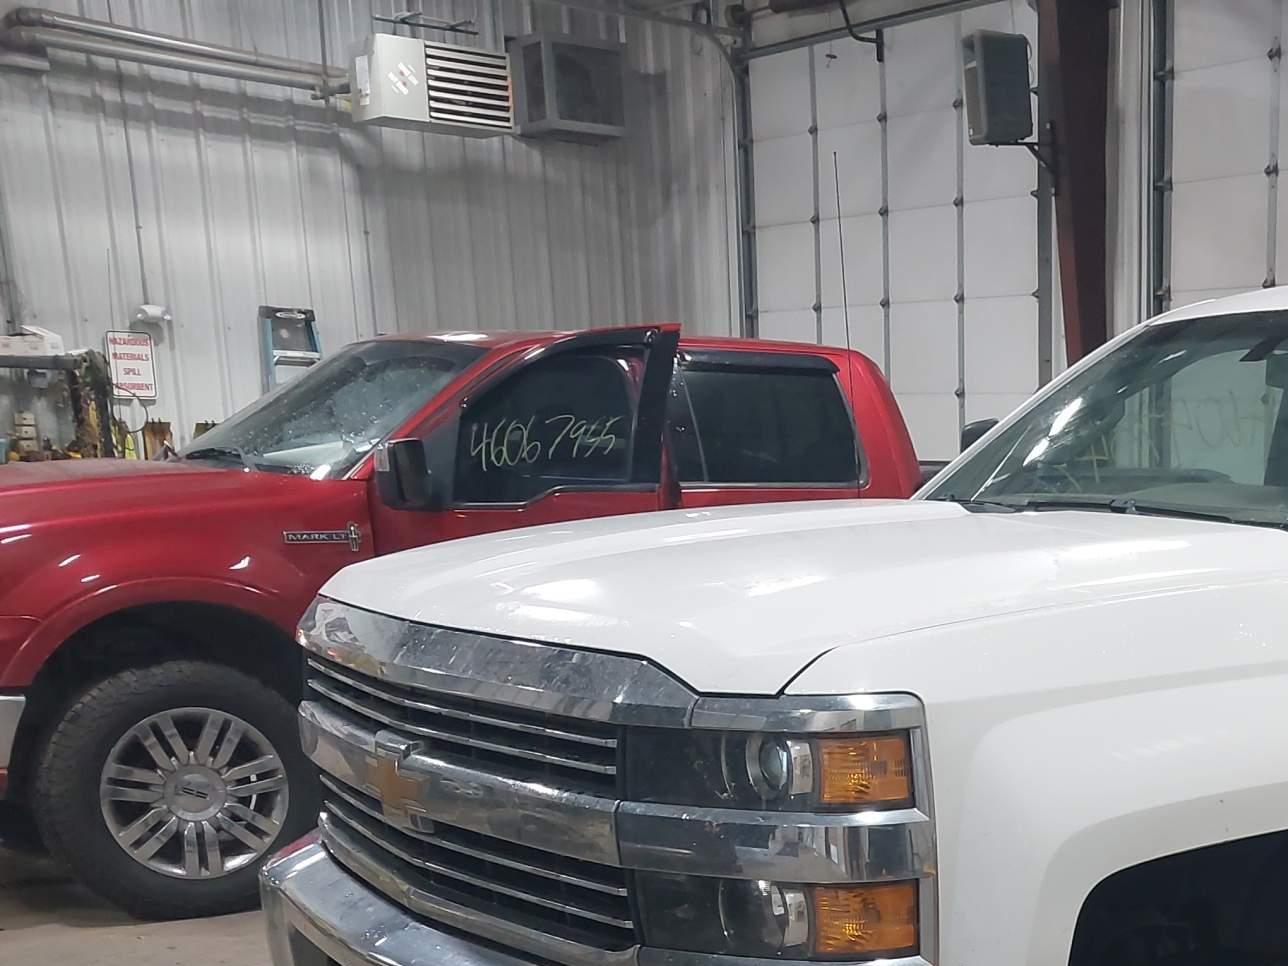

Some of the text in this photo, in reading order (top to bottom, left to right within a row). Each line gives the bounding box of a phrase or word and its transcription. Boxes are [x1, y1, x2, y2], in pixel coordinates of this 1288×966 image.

[112, 352, 150, 361] MATERIALS
[123, 367, 142, 376] SPILL
[287, 533, 328, 541] MARK
